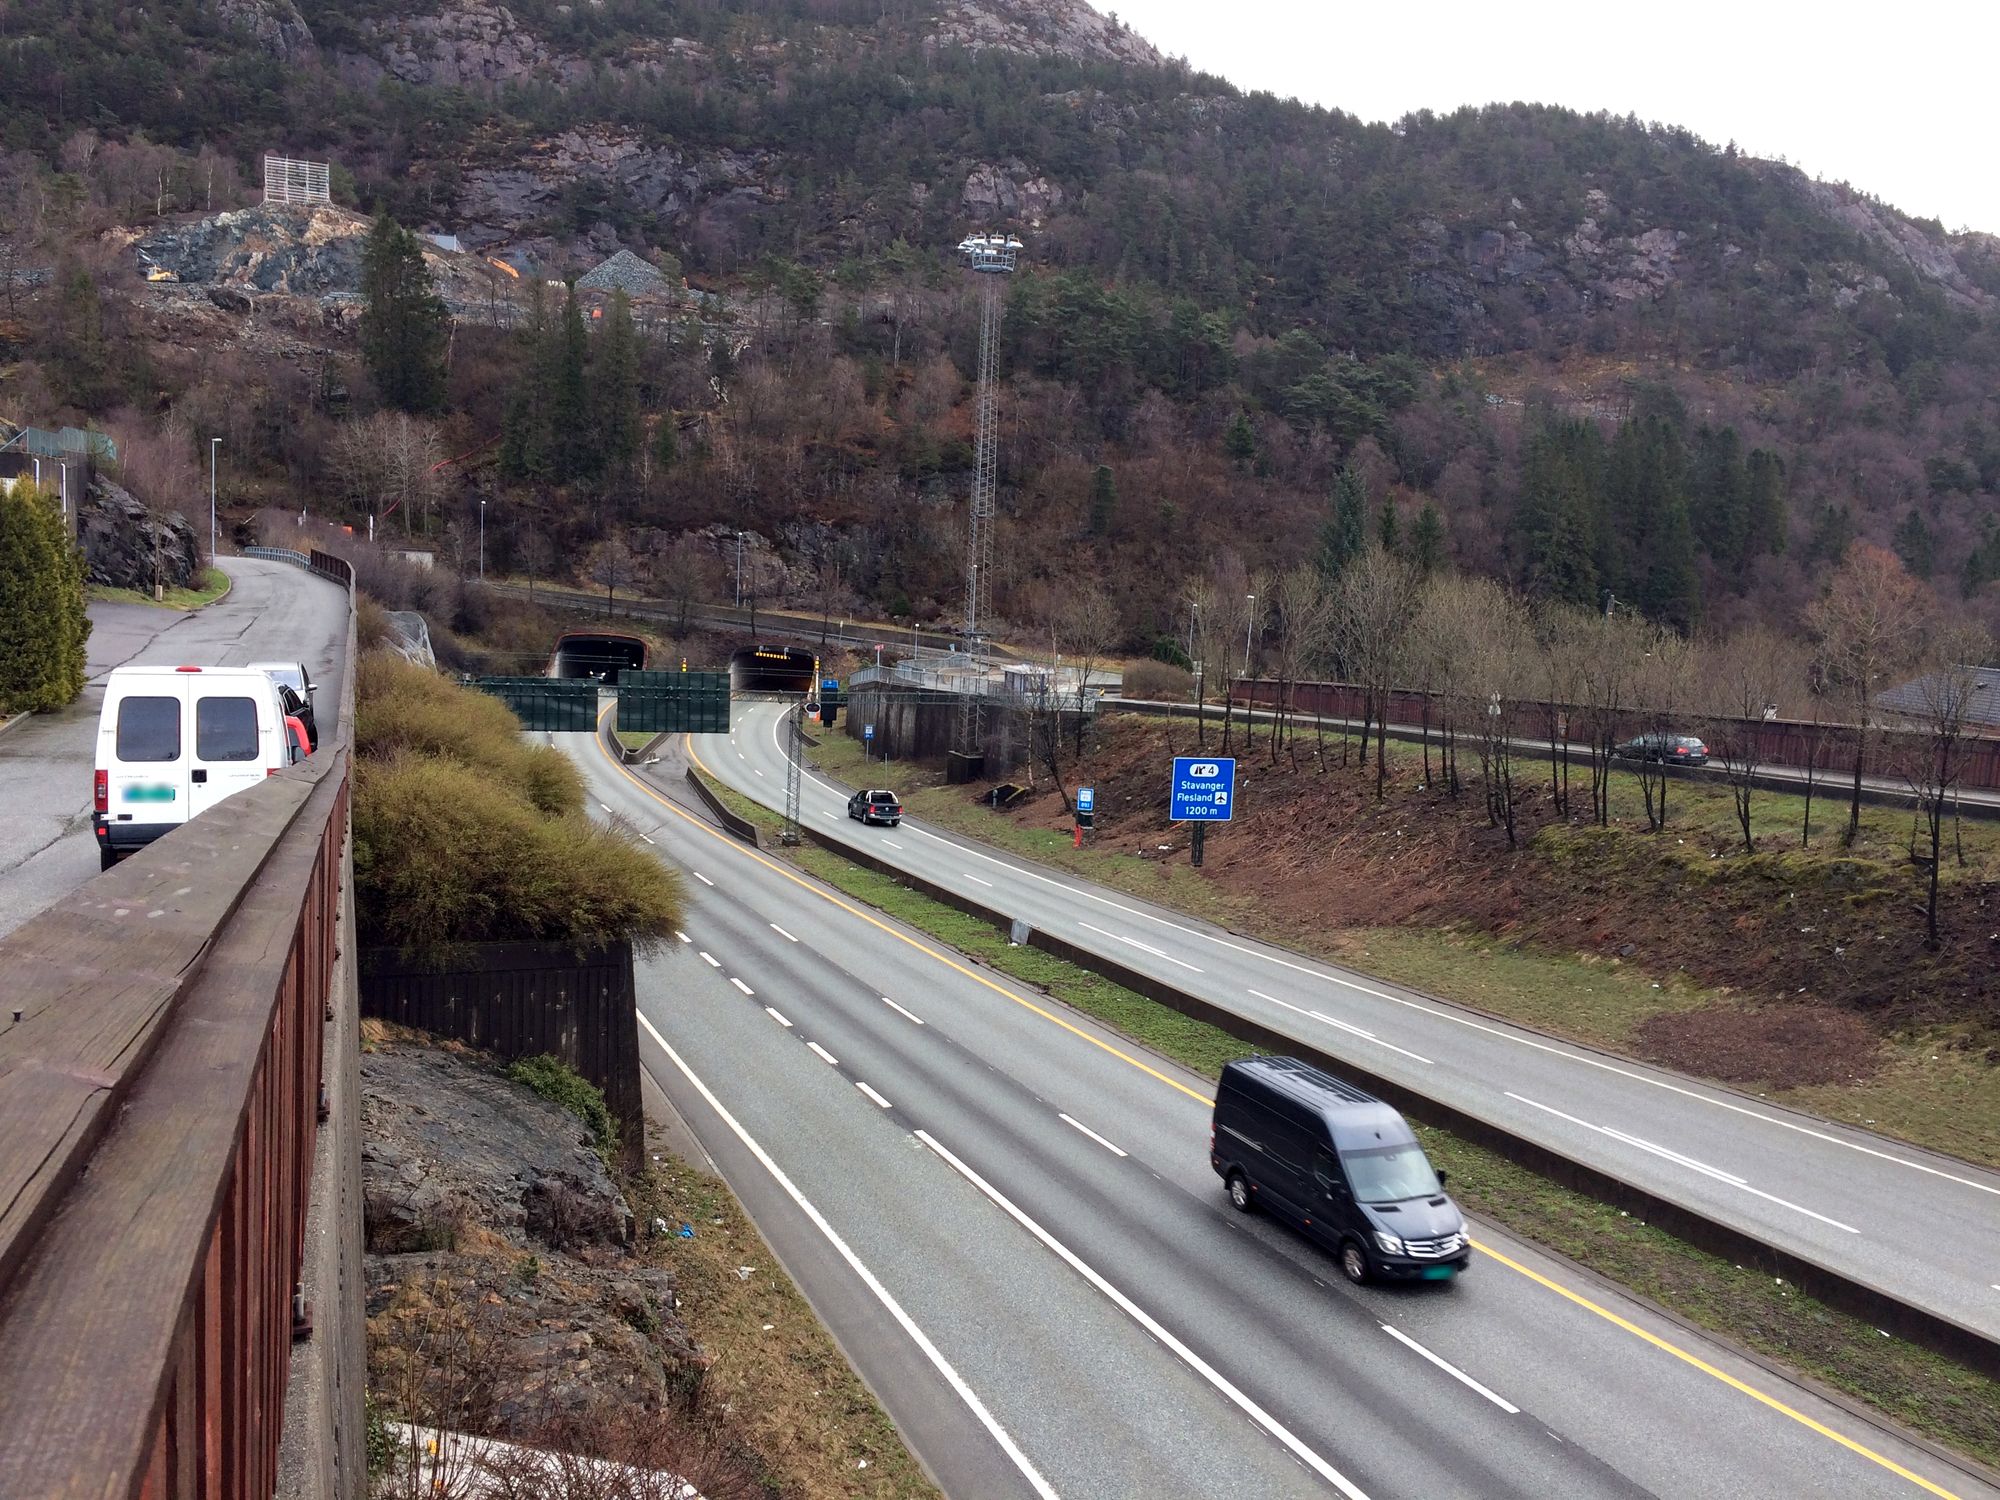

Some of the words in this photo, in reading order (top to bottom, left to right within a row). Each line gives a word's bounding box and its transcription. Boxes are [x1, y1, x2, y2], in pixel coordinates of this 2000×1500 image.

[1208, 766, 1215, 775] 4
[1181, 781, 1225, 791] Stavanger
[1177, 793, 1213, 802] Flesland
[1185, 806, 1208, 815] 1200
